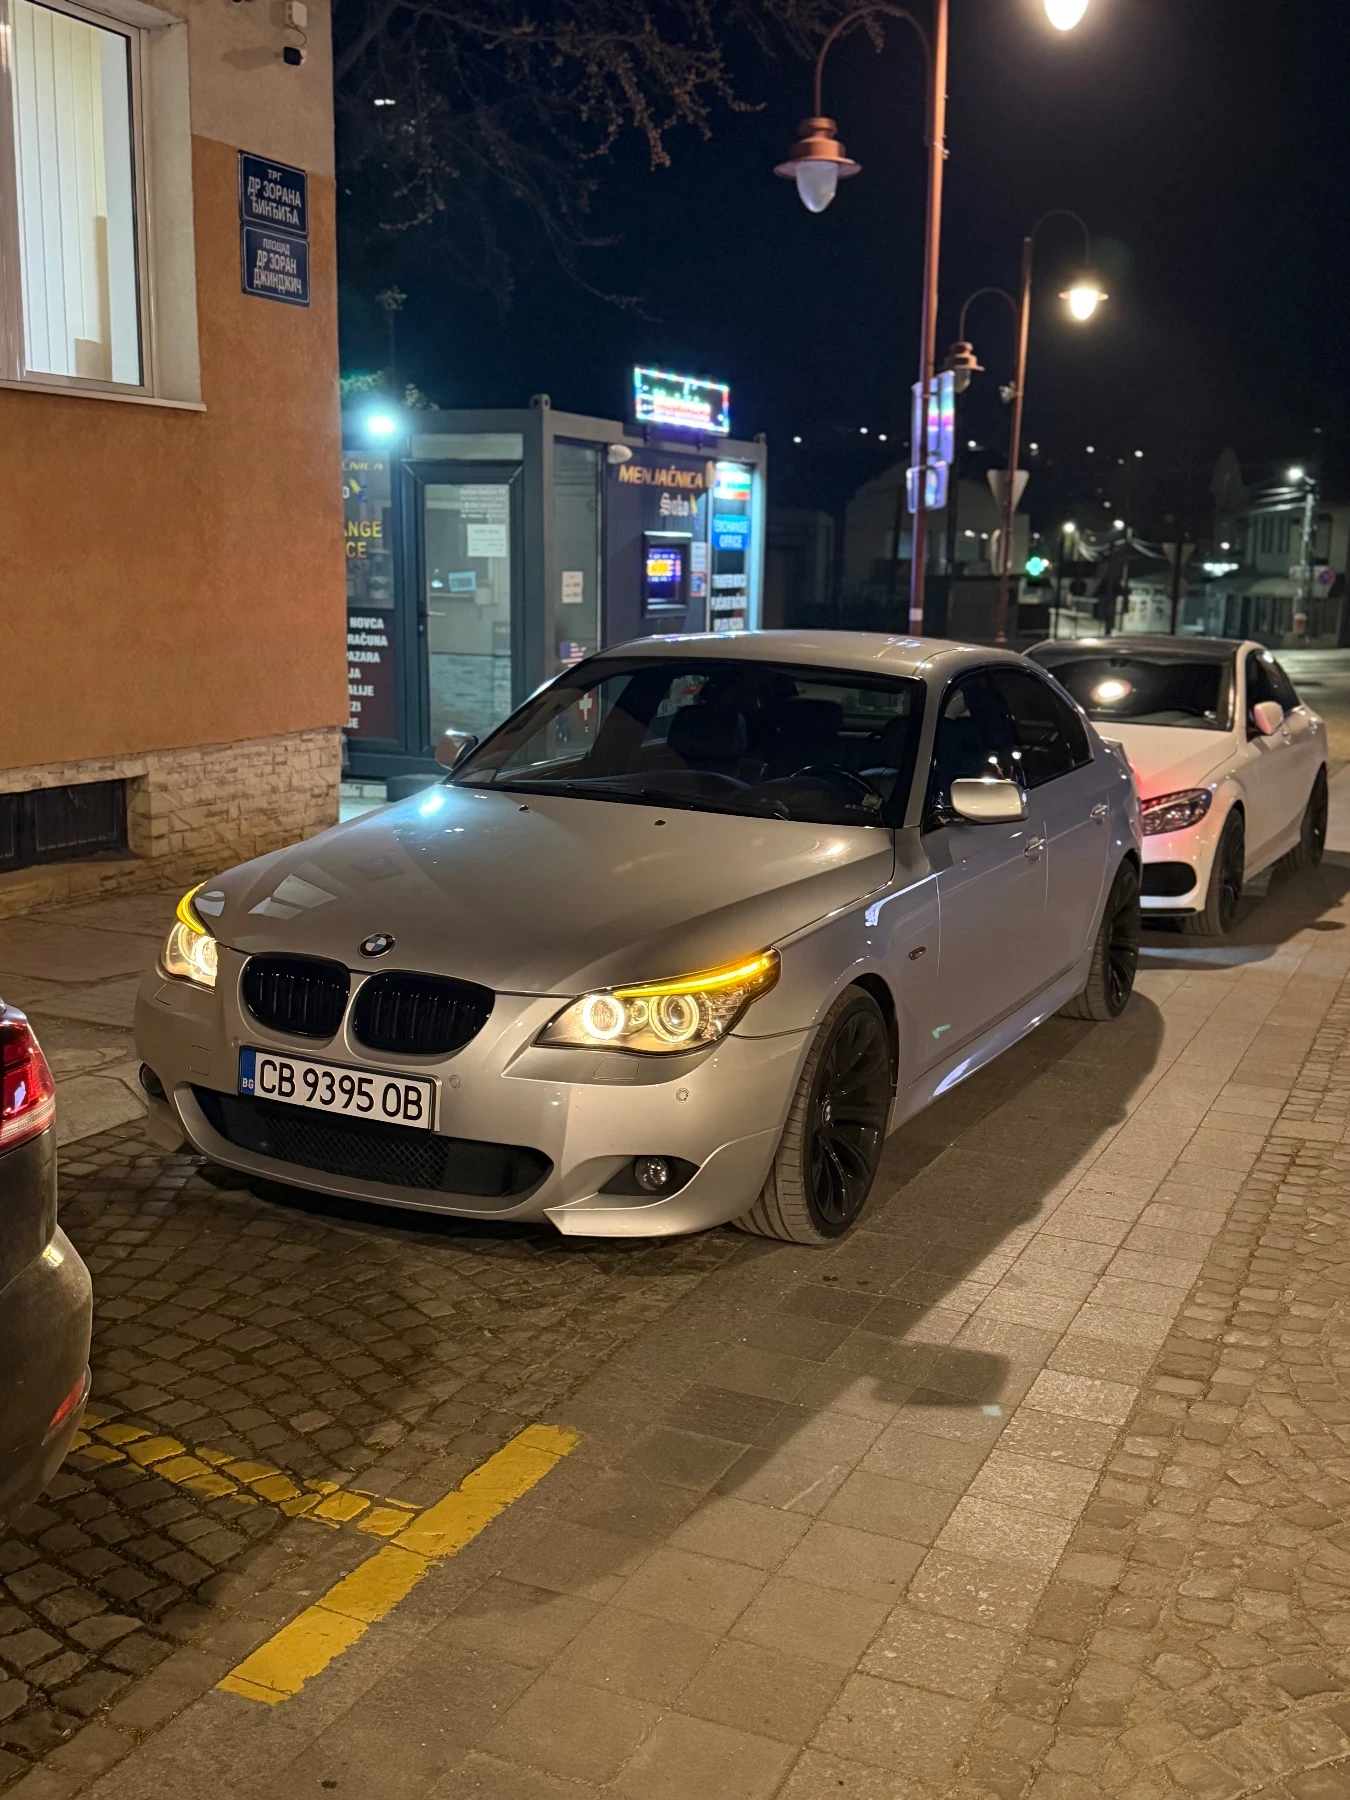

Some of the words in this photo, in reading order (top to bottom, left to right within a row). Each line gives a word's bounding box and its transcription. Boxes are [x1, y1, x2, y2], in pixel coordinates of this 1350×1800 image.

[267, 169, 283, 181] ТРГ
[247, 176, 261, 196] ДР
[263, 180, 302, 207] ЗОРАНА
[250, 194, 299, 225] ЂИНЂИЋА
[262, 238, 291, 256] ПЛОЩАД
[256, 249, 268, 269] ДР
[269, 253, 297, 275] ЗОРАН
[253, 268, 302, 294] ДЖИНДЖИЧ
[618, 464, 703, 489] MENJAČNICA
[719, 534, 743, 549] OFFICE
[349, 616, 385, 629] NOVCA
[347, 632, 389, 647] RAČUNA
[346, 651, 381, 663] AZARA
[349, 700, 362, 712] ZI
[242, 1077, 254, 1089] BG
[259, 1059, 296, 1098] CB
[302, 1067, 375, 1113] 9395
[381, 1082, 423, 1121] OB
